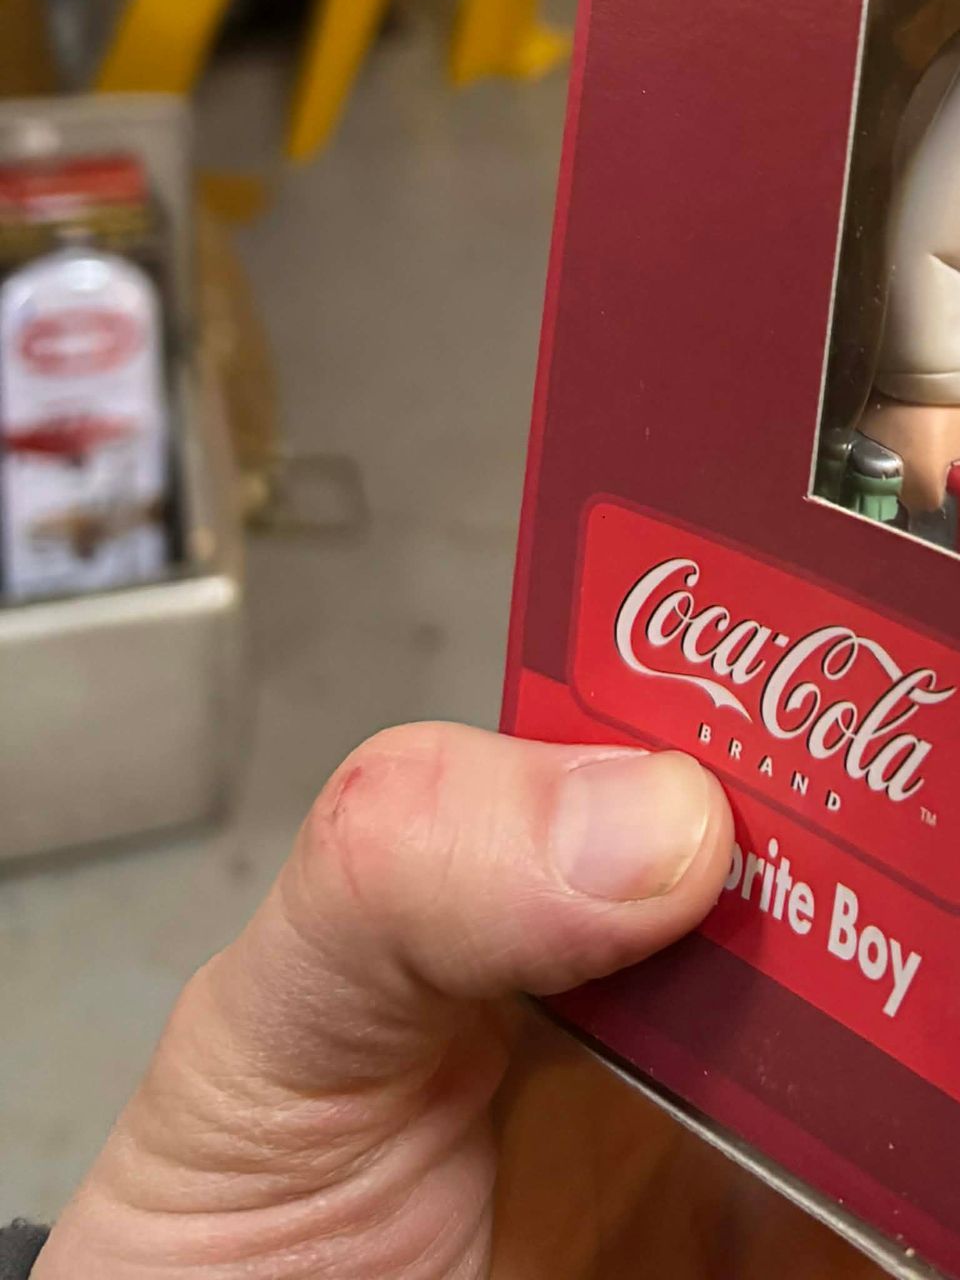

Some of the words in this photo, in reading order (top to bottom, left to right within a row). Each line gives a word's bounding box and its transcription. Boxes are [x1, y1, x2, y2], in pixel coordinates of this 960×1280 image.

[614, 557, 957, 802] Coca-Cola
[698, 722, 842, 812] BRAND
[827, 882, 923, 1018] Boy
